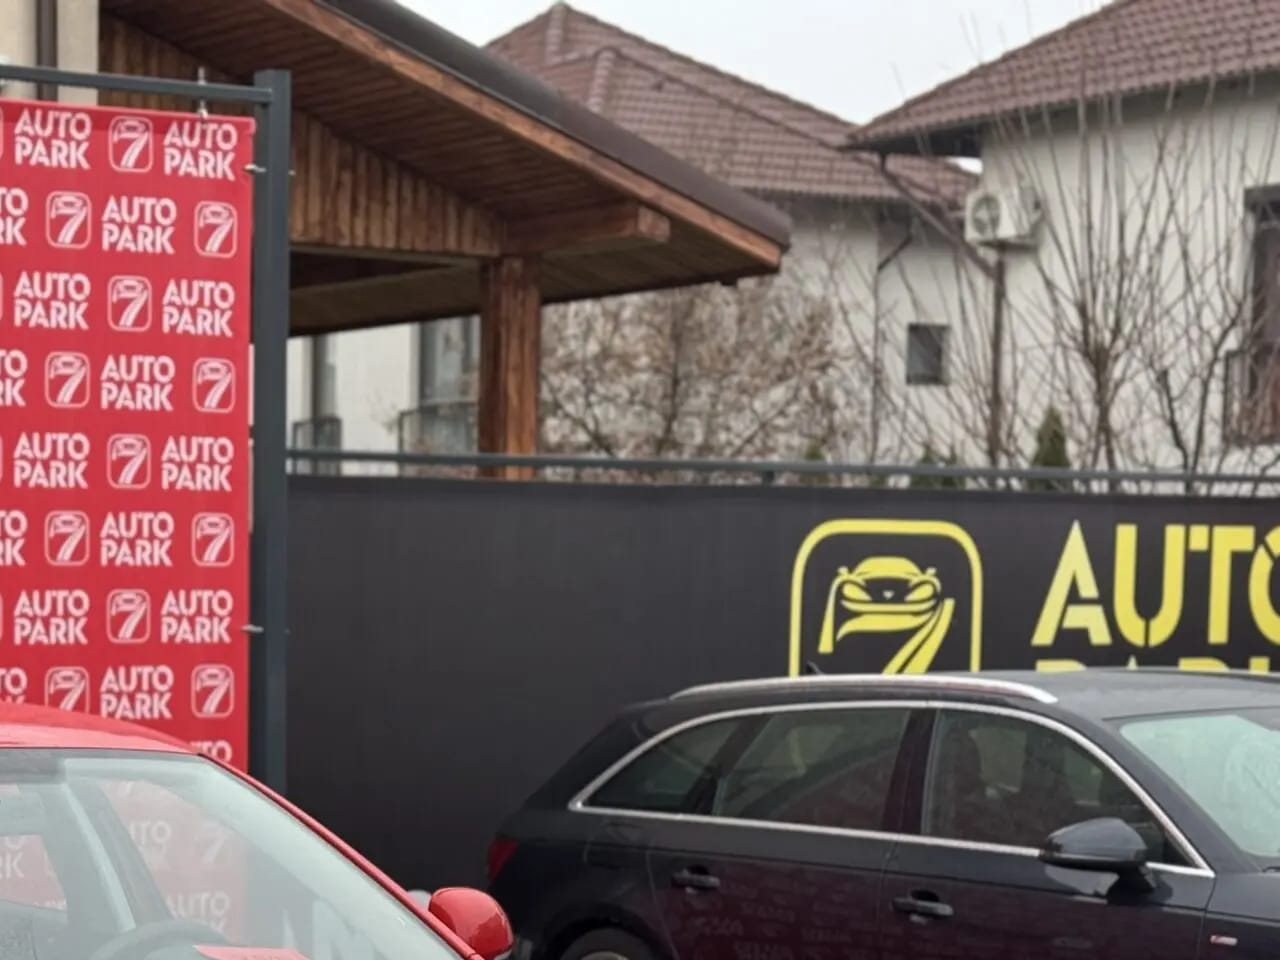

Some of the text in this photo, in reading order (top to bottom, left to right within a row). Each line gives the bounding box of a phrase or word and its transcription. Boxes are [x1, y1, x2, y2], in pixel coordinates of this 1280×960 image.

[15, 110, 91, 141] AUTO
[164, 123, 238, 152] AUTO
[14, 139, 90, 169] PARK
[164, 151, 236, 181] PARK
[102, 198, 176, 226] AUTO
[102, 224, 175, 254] PARK
[14, 274, 90, 301] AUTO
[162, 282, 234, 309] AUTO
[14, 300, 89, 329] PARK
[162, 307, 233, 336] PARK
[101, 356, 174, 383] AUTO
[101, 382, 173, 411] PARK
[14, 432, 89, 461] AUTO
[161, 437, 234, 464] AUTO
[14, 459, 89, 489] PARK
[161, 463, 232, 492] PARK
[101, 512, 174, 539] AUTO
[101, 539, 172, 567] PARK
[14, 590, 89, 617] AUTO
[161, 589, 232, 615] AUTO
[14, 617, 89, 645] PARK
[161, 615, 231, 643] PARK
[101, 666, 174, 692] AUTO
[101, 691, 171, 719] PARK
